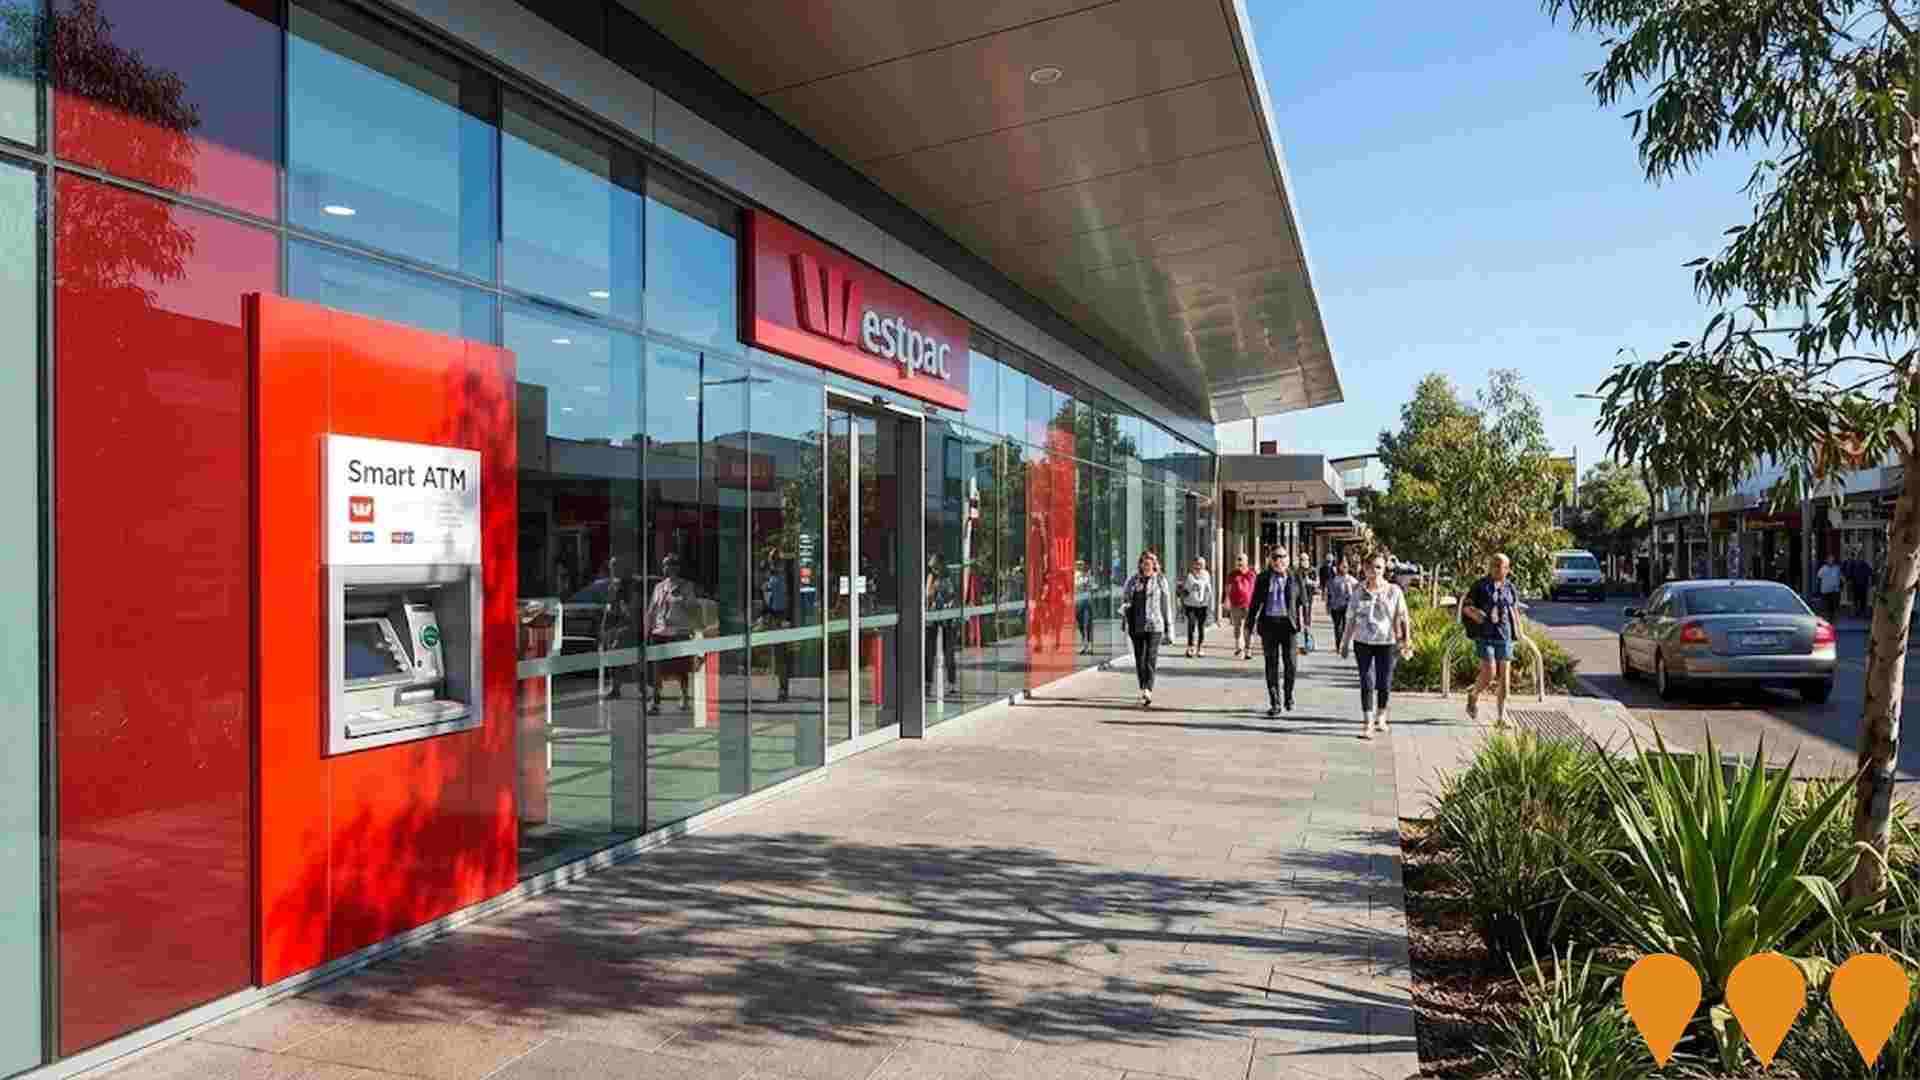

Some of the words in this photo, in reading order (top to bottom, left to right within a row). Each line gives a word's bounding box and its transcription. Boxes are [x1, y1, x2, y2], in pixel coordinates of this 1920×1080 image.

[788, 253, 951, 380] Westpac
[348, 459, 416, 487] Smart
[423, 466, 466, 491] ATM
